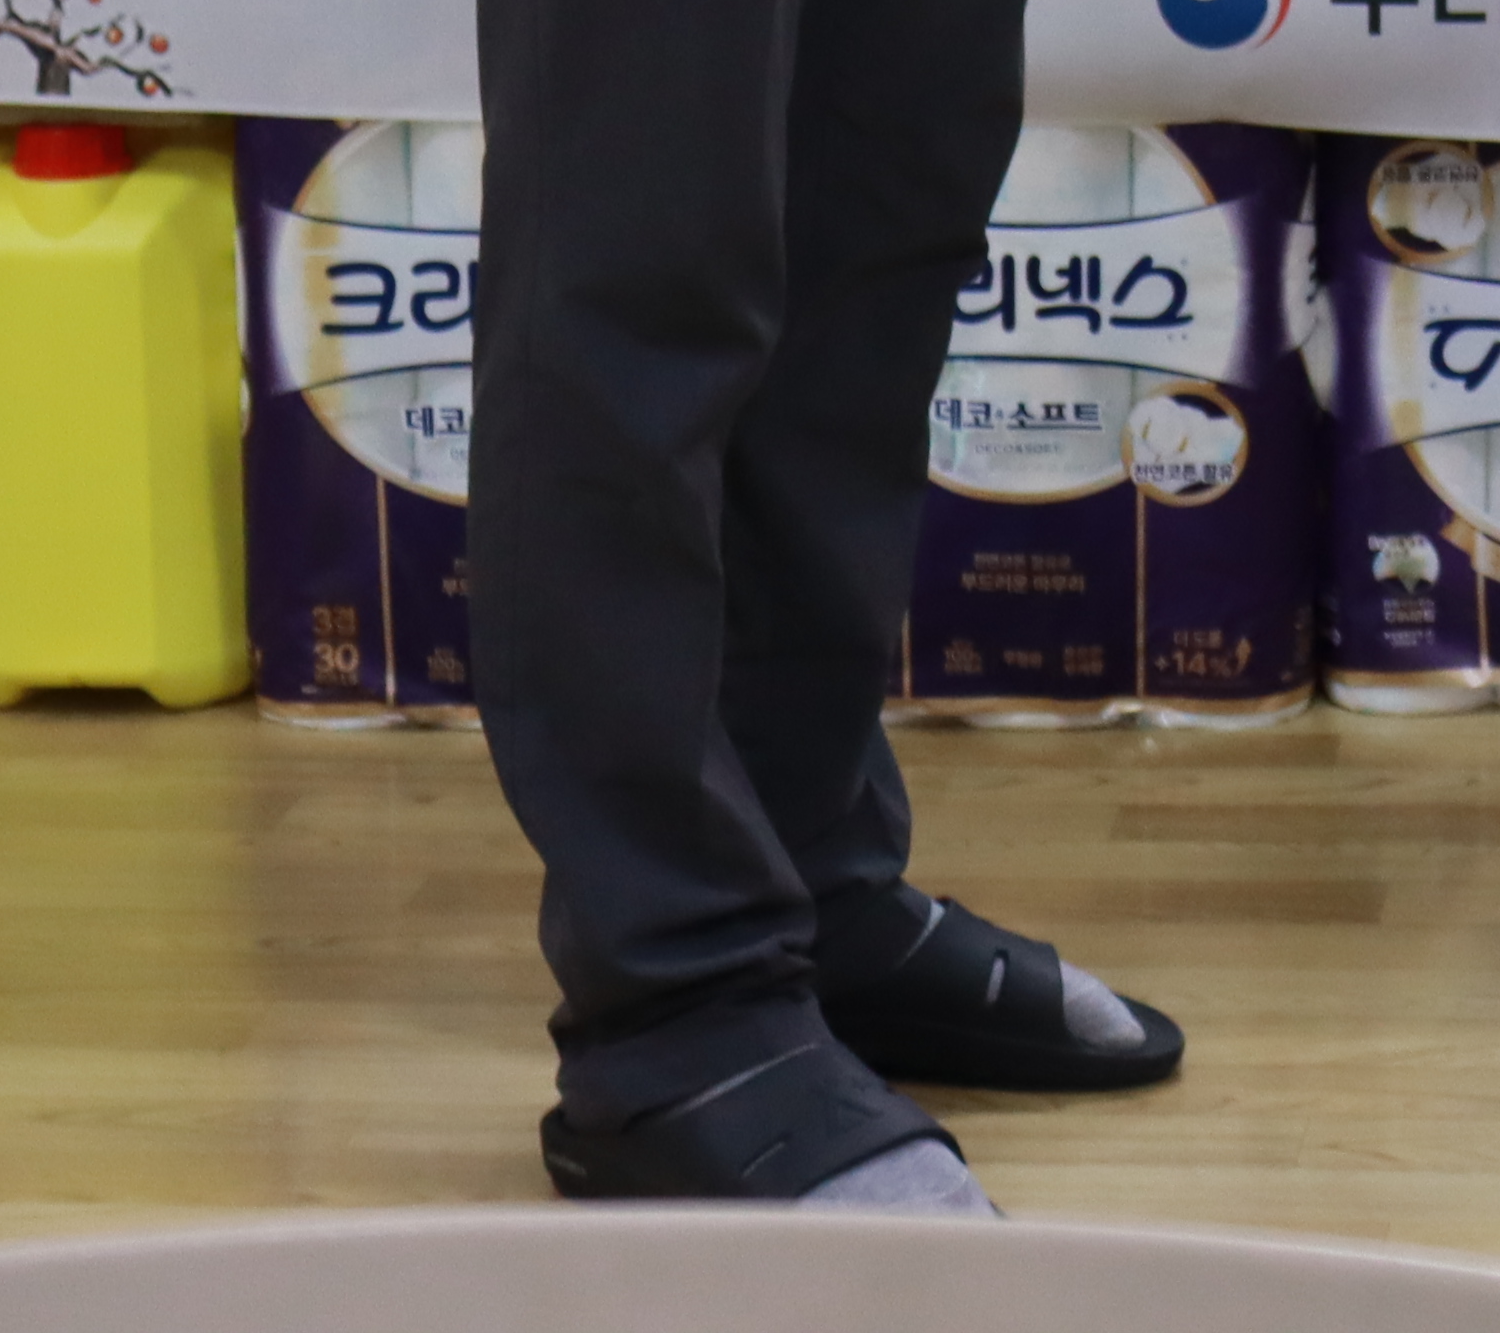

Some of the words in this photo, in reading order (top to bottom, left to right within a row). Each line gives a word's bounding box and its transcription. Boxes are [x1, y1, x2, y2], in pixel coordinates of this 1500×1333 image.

[321, 260, 479, 336] 크리
[953, 253, 1194, 334] 리넥스
[314, 642, 360, 674] 30
